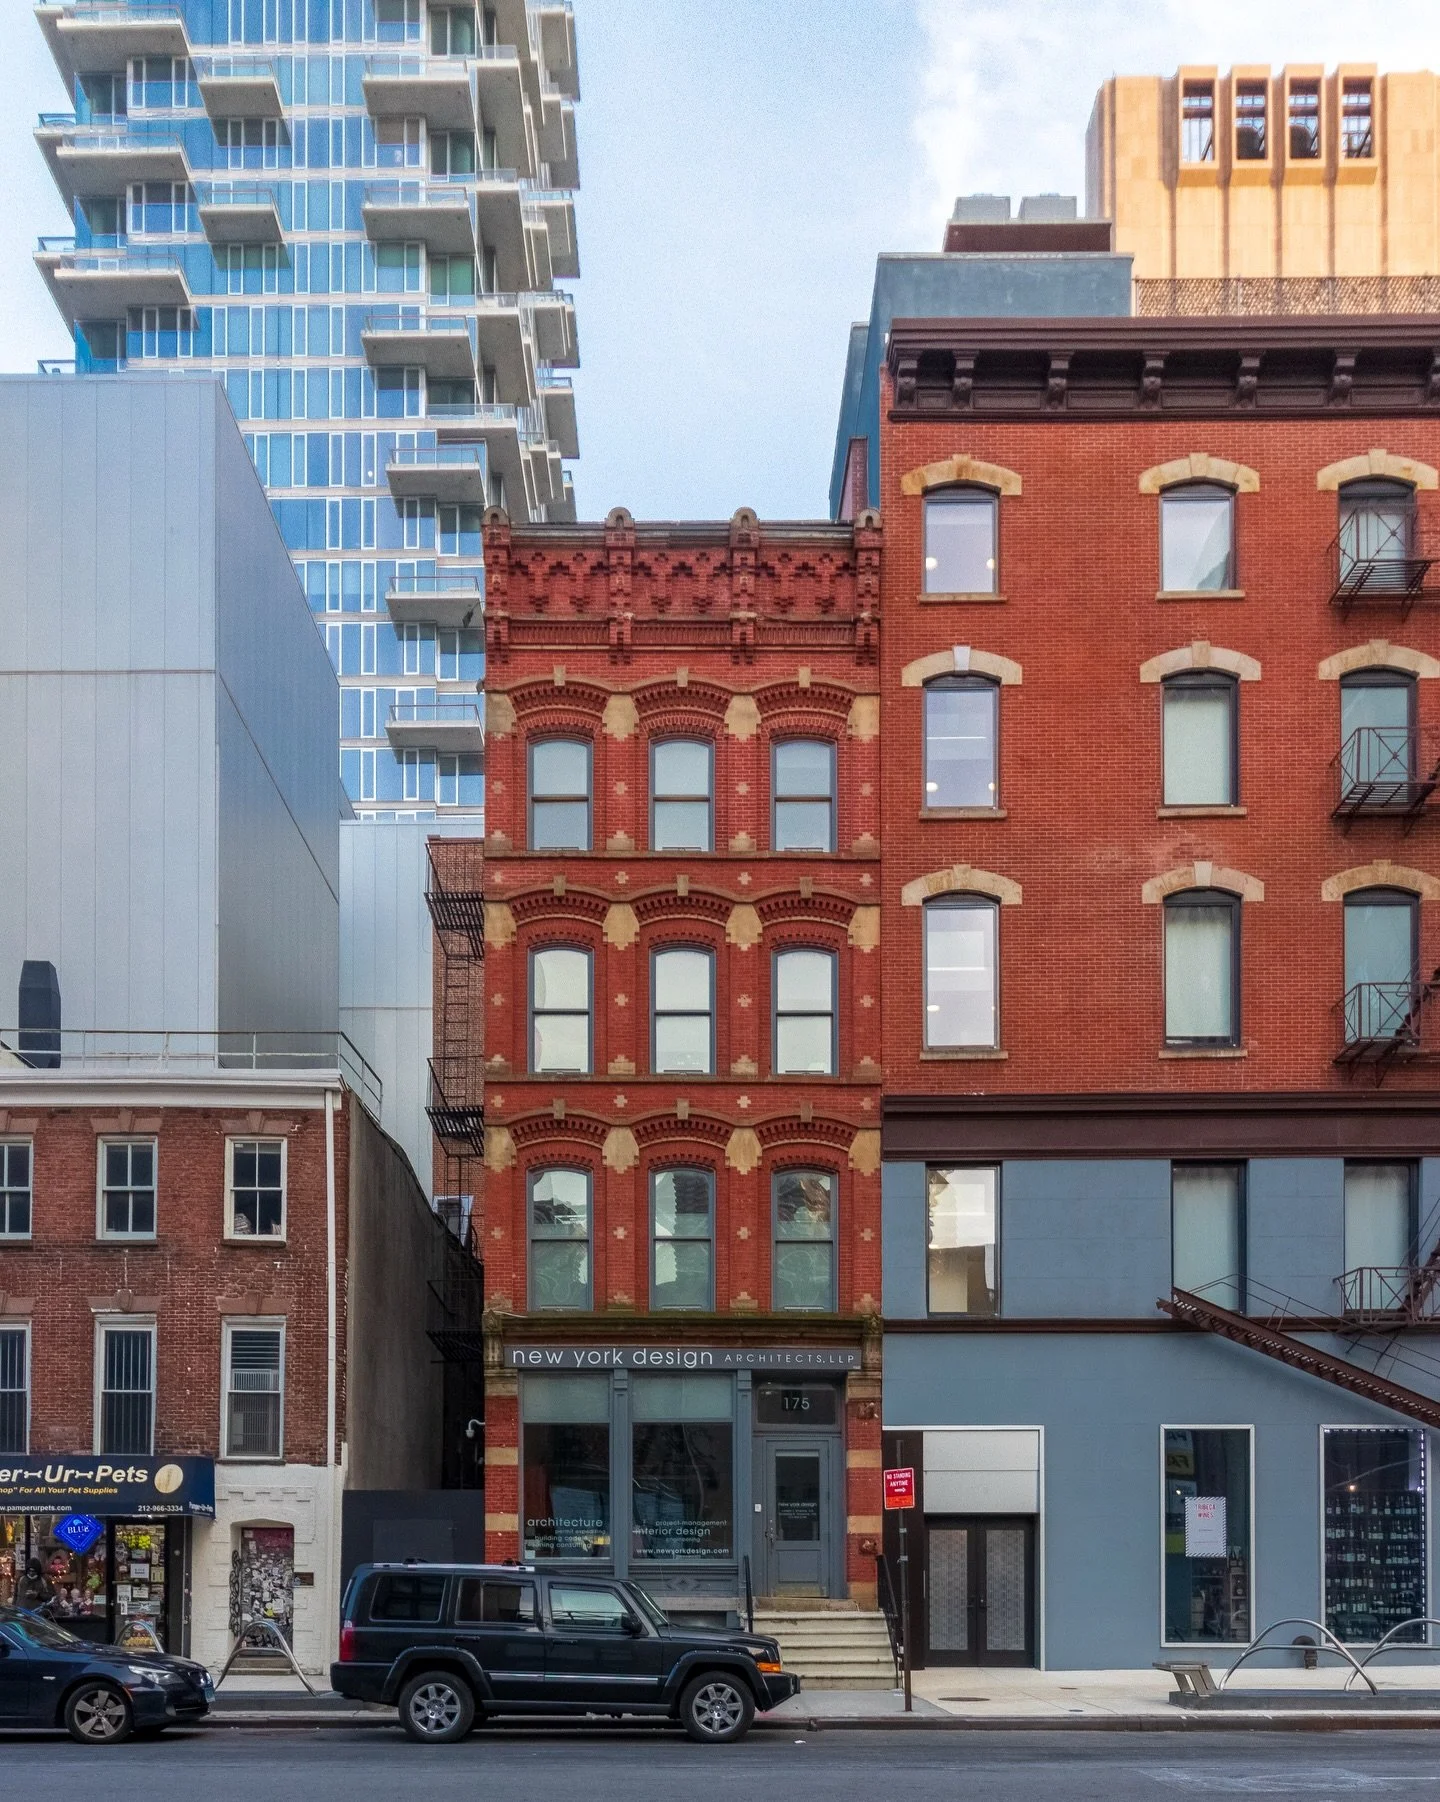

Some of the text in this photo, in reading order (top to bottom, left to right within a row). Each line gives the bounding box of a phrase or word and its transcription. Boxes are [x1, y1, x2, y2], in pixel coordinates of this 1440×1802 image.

[512, 1349, 564, 1364] new
[573, 1348, 623, 1368] york
[632, 1348, 713, 1368] design
[783, 1397, 810, 1410] 175
[44, 1464, 75, 1483] Ur
[95, 1465, 148, 1482] Pets
[893, 1472, 911, 1480] STANDING
[83, 1487, 118, 1495] Supplies
[527, 1517, 603, 1527] architecture
[67, 1526, 90, 1534] BLUE
[635, 1526, 711, 1537] interior design
